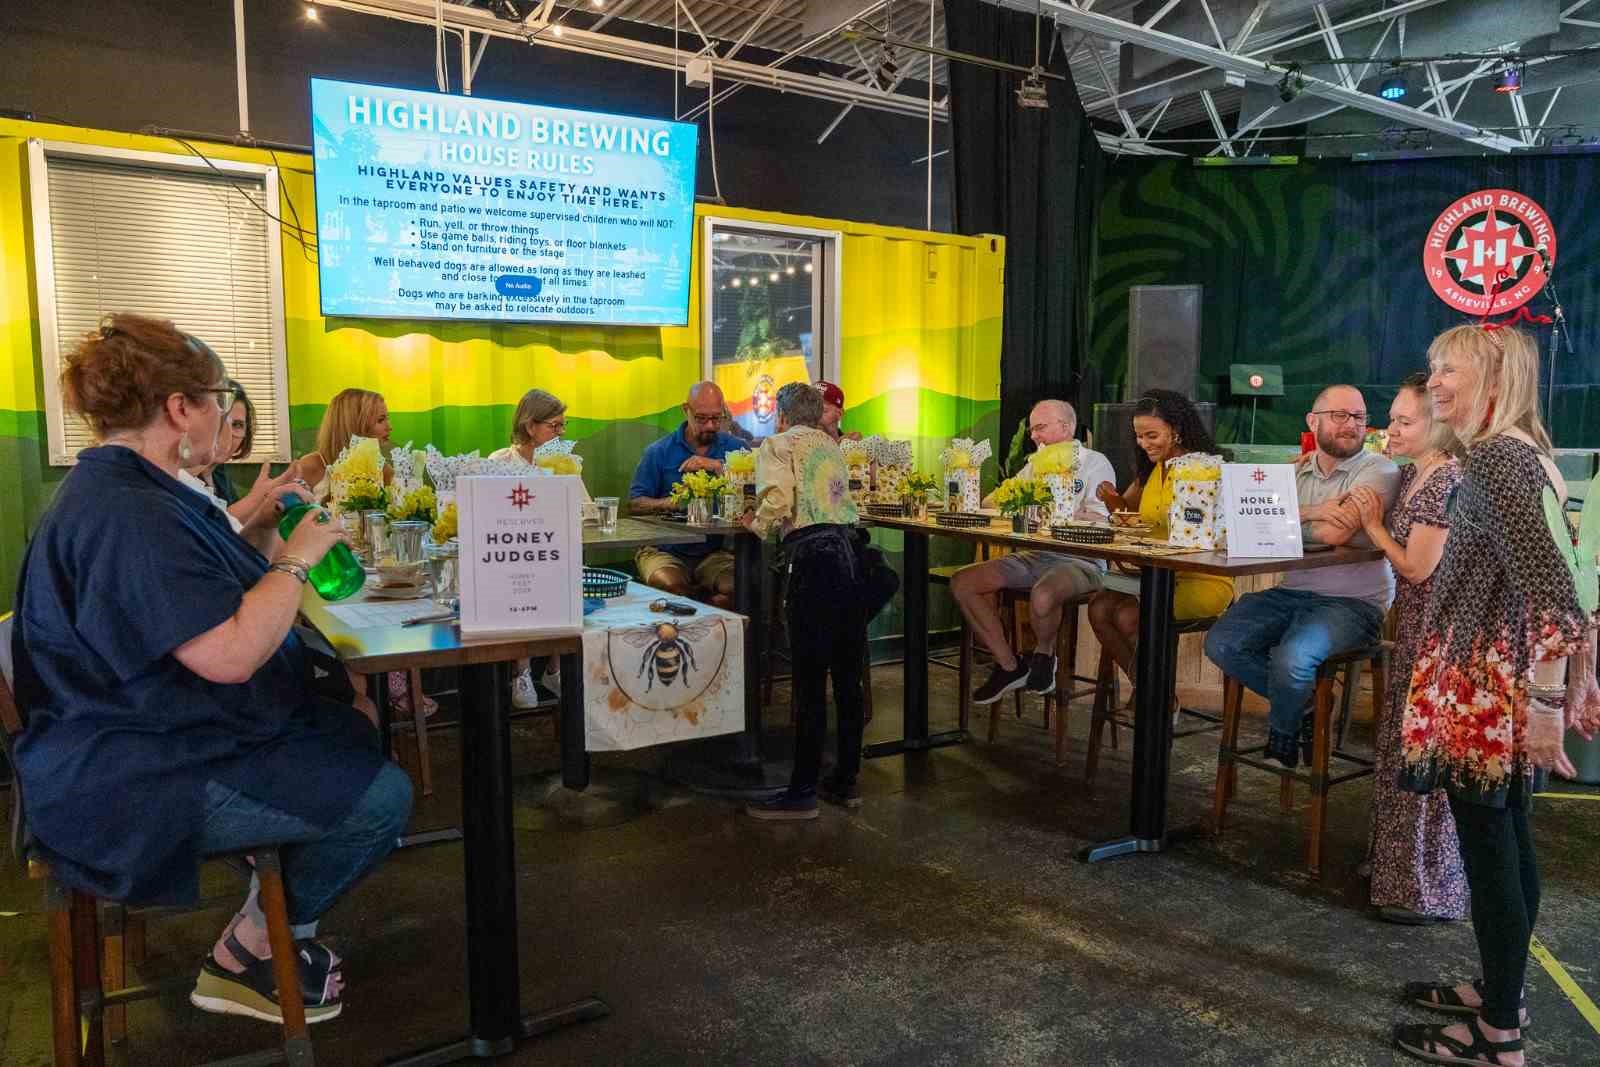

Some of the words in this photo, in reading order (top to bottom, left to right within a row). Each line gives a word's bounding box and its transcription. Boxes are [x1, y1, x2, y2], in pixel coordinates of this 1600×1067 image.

[348, 95, 521, 140] HIGHLAND
[531, 116, 670, 156] BREWING
[441, 141, 520, 168] HOUSE
[527, 149, 594, 174] RULES
[358, 165, 445, 182] HIGHLAND
[453, 173, 512, 188] VALUES
[519, 178, 577, 193] SAFETY
[582, 185, 612, 197] AND
[618, 189, 666, 201] WANTS
[386, 180, 473, 195] EVERYONE
[480, 187, 499, 197] TO
[507, 190, 556, 202] ENJOY
[562, 194, 596, 206] TIME
[603, 198, 644, 209] HERE.
[339, 195, 350, 205] In
[353, 195, 369, 207] the
[373, 197, 416, 212] taproom
[419, 202, 438, 212] and
[441, 204, 466, 218] patio
[469, 207, 482, 215] we
[485, 207, 527, 218] welcome
[530, 211, 580, 222] supervised
[582, 214, 618, 225] children
[620, 217, 638, 226] who
[640, 219, 655, 228] will
[657, 220, 673, 229] NOT
[1430, 194, 1493, 248] HIGHLAND
[1499, 194, 1551, 245] BREWING
[420, 218, 440, 229] Run,
[445, 219, 464, 231] yell,
[469, 222, 478, 230] or
[481, 222, 508, 233] throw
[511, 225, 539, 238] things
[420, 230, 439, 239] Use
[441, 232, 469, 242] game
[472, 232, 497, 243] balls,
[500, 235, 527, 246] riding
[529, 236, 551, 247] toys,
[554, 239, 563, 247] or
[566, 239, 586, 249] floor
[590, 240, 626, 251] blankets
[420, 241, 448, 251] Stand
[451, 243, 464, 251] on
[466, 242, 507, 254] furniture
[522, 247, 537, 256] the
[540, 247, 565, 259] stage
[1473, 238, 1507, 267] H
[374, 257, 395, 267] Well
[398, 258, 441, 269] behaved
[444, 261, 467, 273] dogs
[470, 263, 485, 271] are
[489, 263, 524, 273] allowed
[527, 266, 537, 274] as
[540, 265, 559, 277] long
[575, 268, 594, 278] they
[596, 270, 611, 278] are
[613, 269, 646, 280] leashed
[1431, 267, 1443, 278] 19
[441, 272, 459, 281] and
[462, 272, 487, 281] close
[549, 277, 560, 286] all
[398, 288, 423, 301] Dogs
[425, 290, 446, 299] who
[448, 292, 464, 300] are
[467, 291, 503, 303] barking
[562, 295, 571, 304] in
[573, 295, 587, 304] the
[589, 296, 625, 307] taproom
[1514, 285, 1531, 300] NC
[435, 302, 456, 312] may
[459, 302, 473, 311] be
[475, 302, 503, 312] asked
[505, 303, 514, 312] to
[516, 303, 554, 313] relocate
[1240, 496, 1281, 504] HONE
[1239, 507, 1286, 516] JUDGES
[487, 531, 555, 545] HONEY
[482, 550, 560, 563] JUDGES
